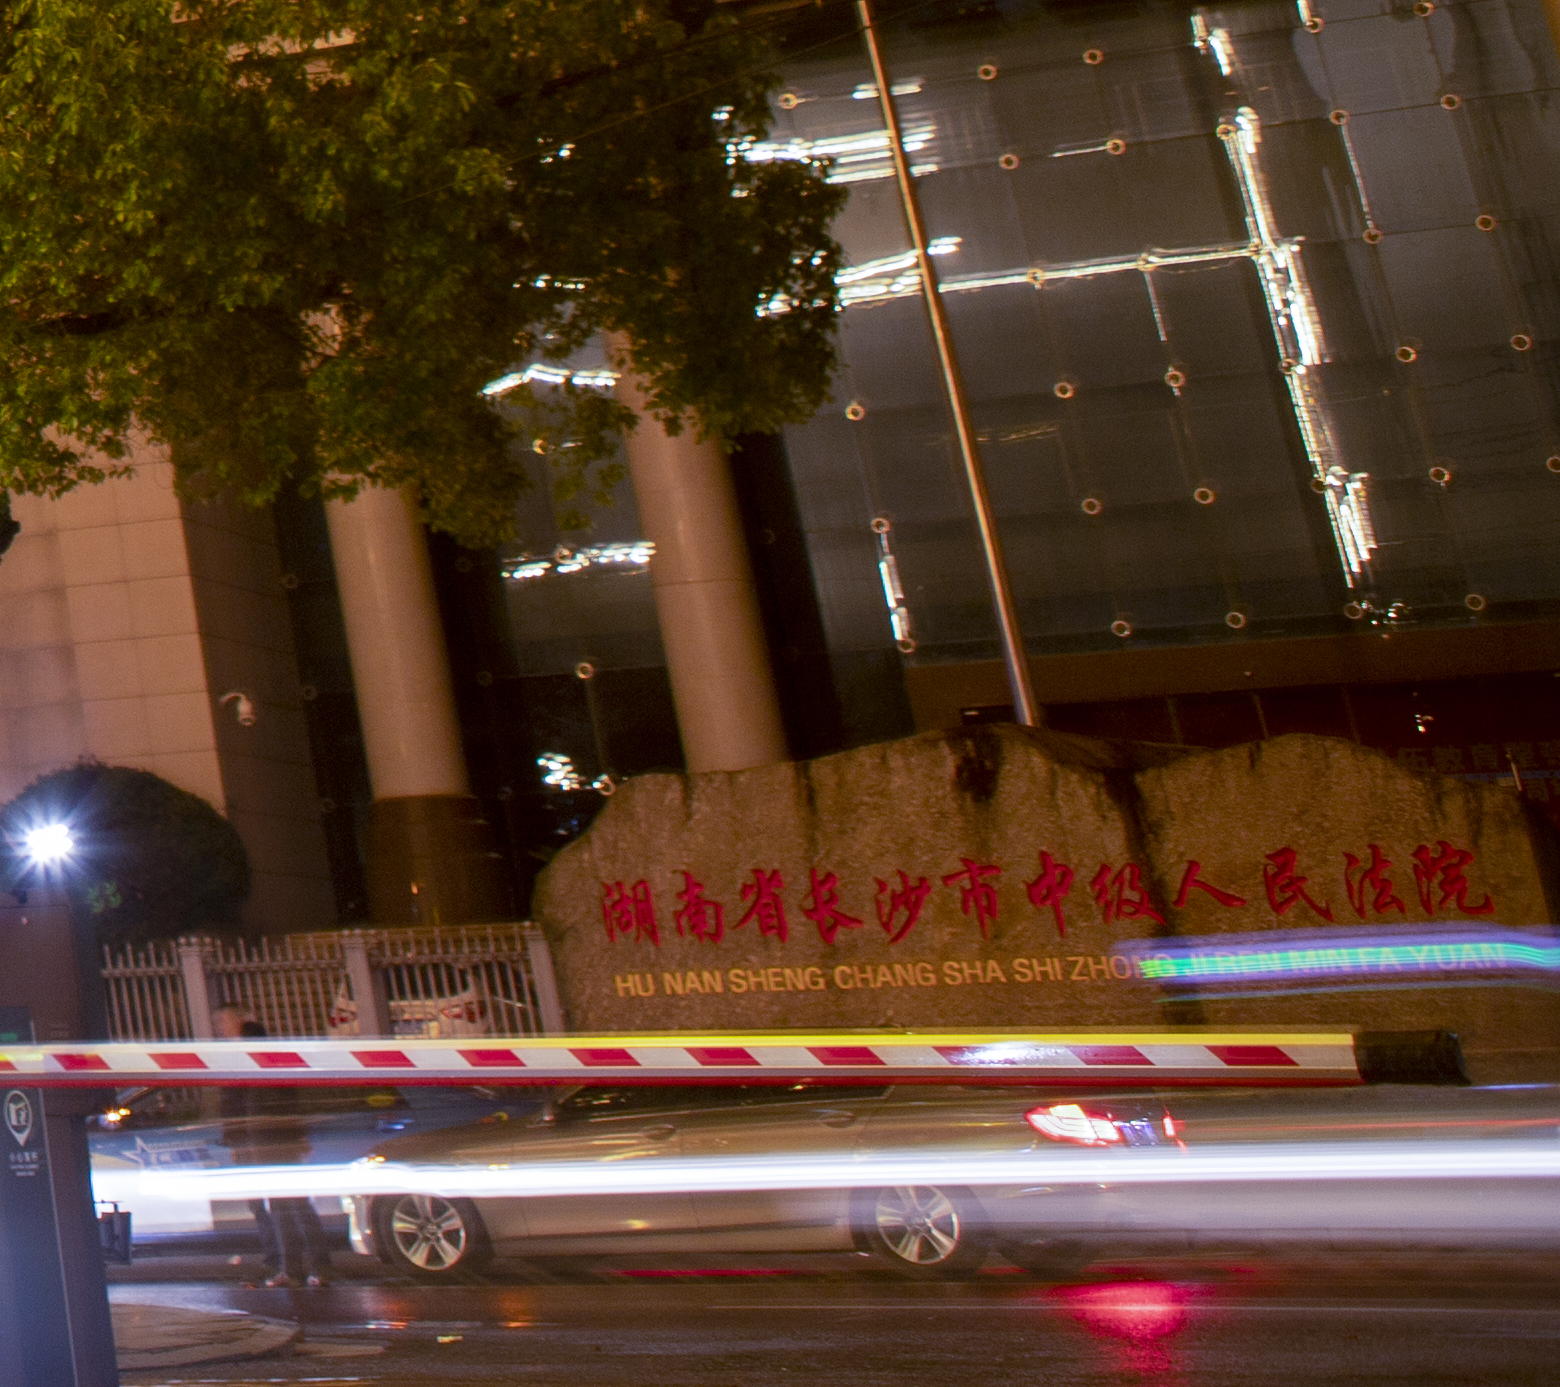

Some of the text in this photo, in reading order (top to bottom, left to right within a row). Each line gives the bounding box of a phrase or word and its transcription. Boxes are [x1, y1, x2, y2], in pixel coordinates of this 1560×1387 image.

[601, 840, 1495, 946] 湖南省长沙市中级人民法院
[615, 973, 655, 998] HU
[664, 970, 722, 996] NAN
[729, 966, 826, 994] SHENG
[834, 962, 937, 990] CHANG
[944, 959, 1007, 986] SHA
[1013, 956, 1064, 982] SHI
[1069, 953, 1173, 983] ZHONG
[1406, 944, 1507, 971] YUAN
